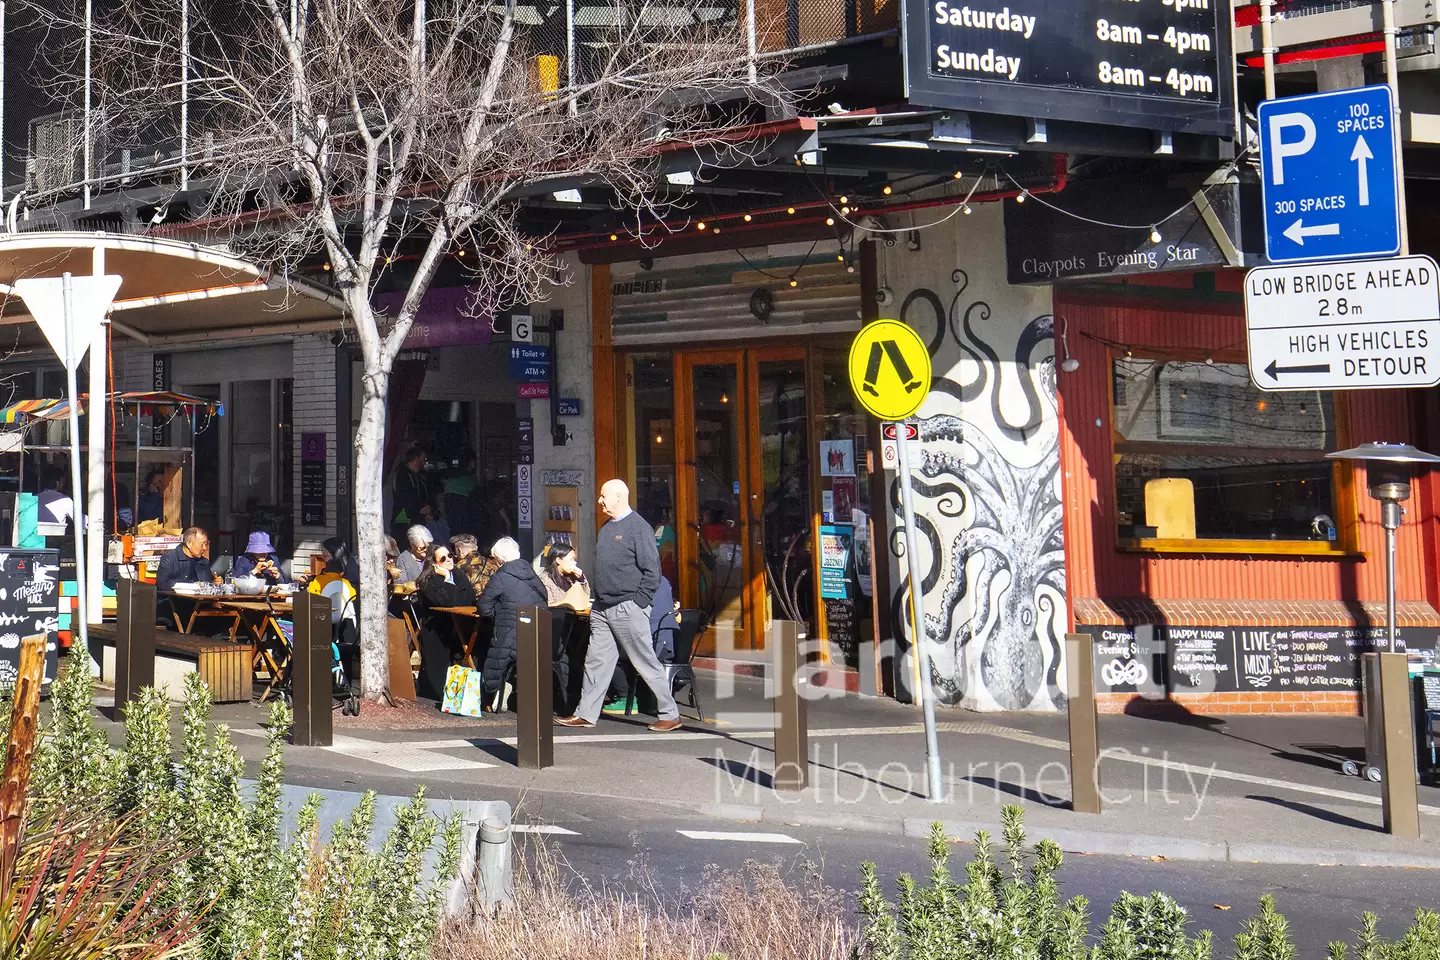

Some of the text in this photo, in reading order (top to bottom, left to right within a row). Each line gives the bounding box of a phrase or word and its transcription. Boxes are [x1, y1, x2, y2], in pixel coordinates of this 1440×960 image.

[935, 1, 1037, 36] Saturday
[1096, 19, 1142, 45] 8am
[1163, 26, 1211, 54] 4pm
[936, 44, 1021, 81] Sunday
[1097, 60, 1144, 87] 8am
[1165, 67, 1213, 97] 4pm
[1349, 103, 1370, 117] 100
[1337, 115, 1384, 133] SPACES
[1268, 111, 1317, 186] P
[1274, 195, 1346, 214] 300 SPACES
[1022, 244, 1199, 278] Claypots Evening Star
[1251, 267, 1430, 297] LOW BRIDGE AHEAD
[516, 323, 529, 339] G
[1289, 329, 1428, 354] HIGH VEHICLES
[521, 349, 538, 358] Toilet
[1344, 356, 1427, 377] DETOUR
[537, 386, 548, 394] Food
[568, 406, 578, 414] Park
[12, 581, 55, 601] Meeting
[1169, 629, 1224, 640] HAPPY HOUR
[1242, 631, 1271, 652] LIVE
[1097, 643, 1150, 659] Evening Star
[1244, 654, 1273, 676] MUSIC
